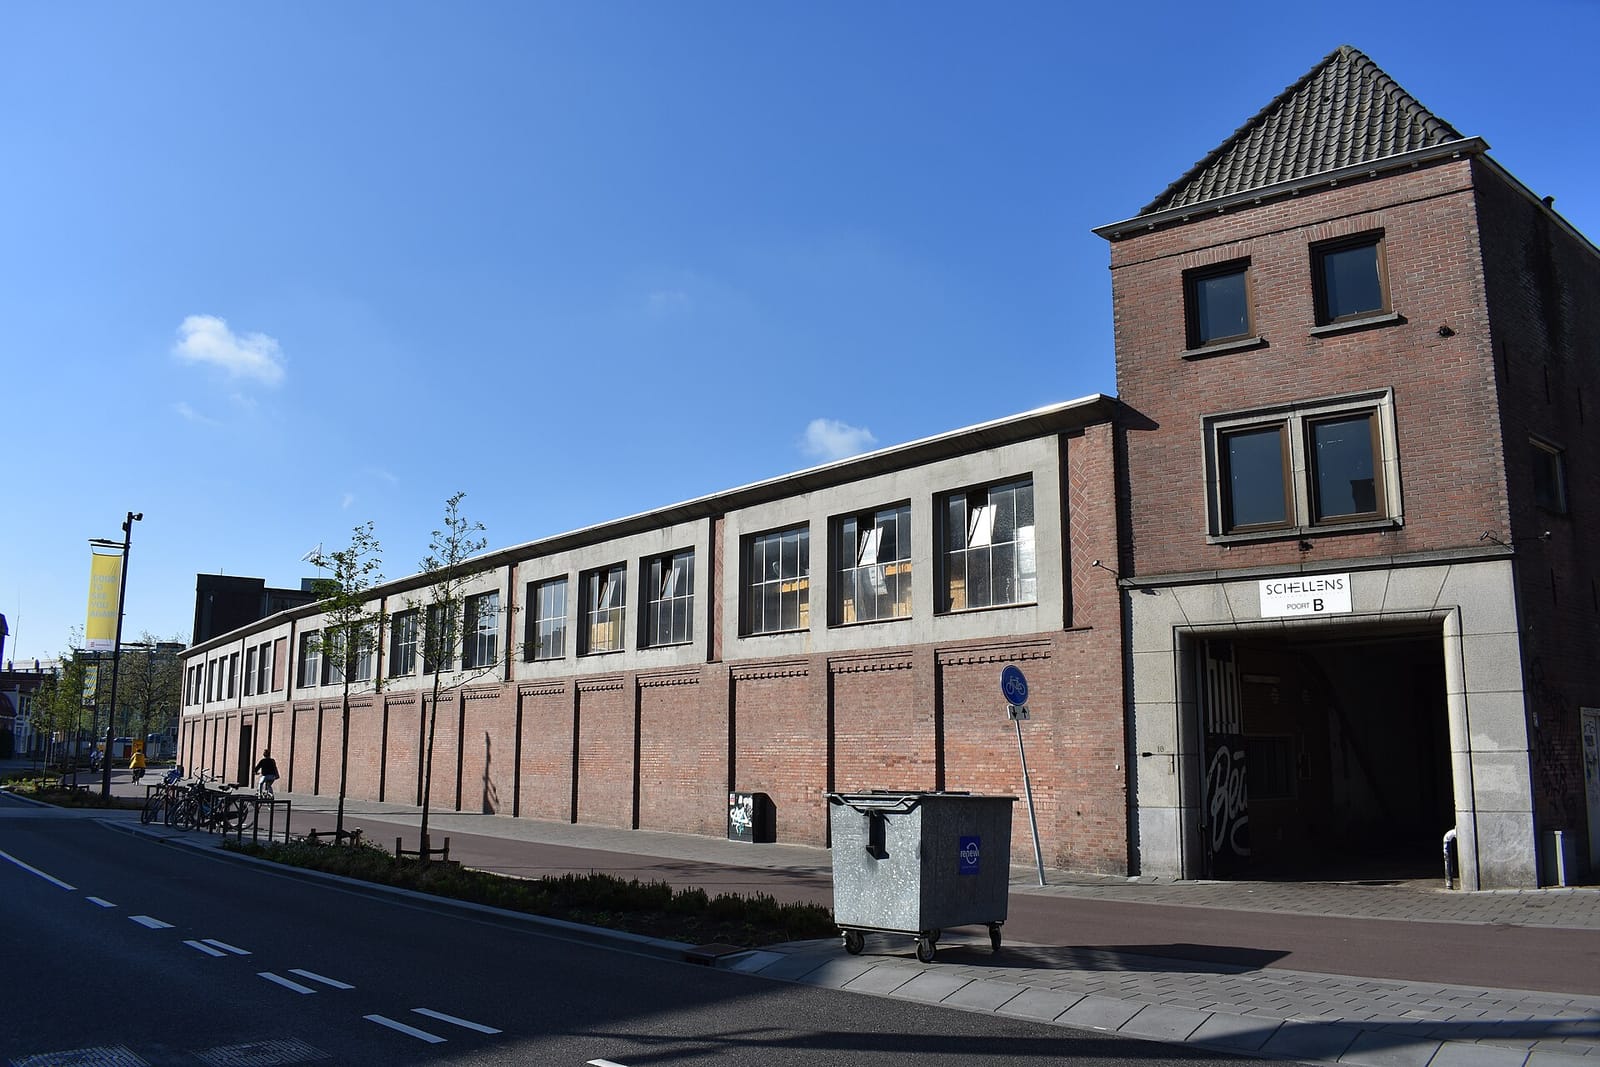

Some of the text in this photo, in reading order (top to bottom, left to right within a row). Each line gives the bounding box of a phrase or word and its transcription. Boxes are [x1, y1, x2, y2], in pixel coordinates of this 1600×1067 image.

[1266, 578, 1344, 595] SCHELLENS
[1286, 598, 1324, 612] POORT B
